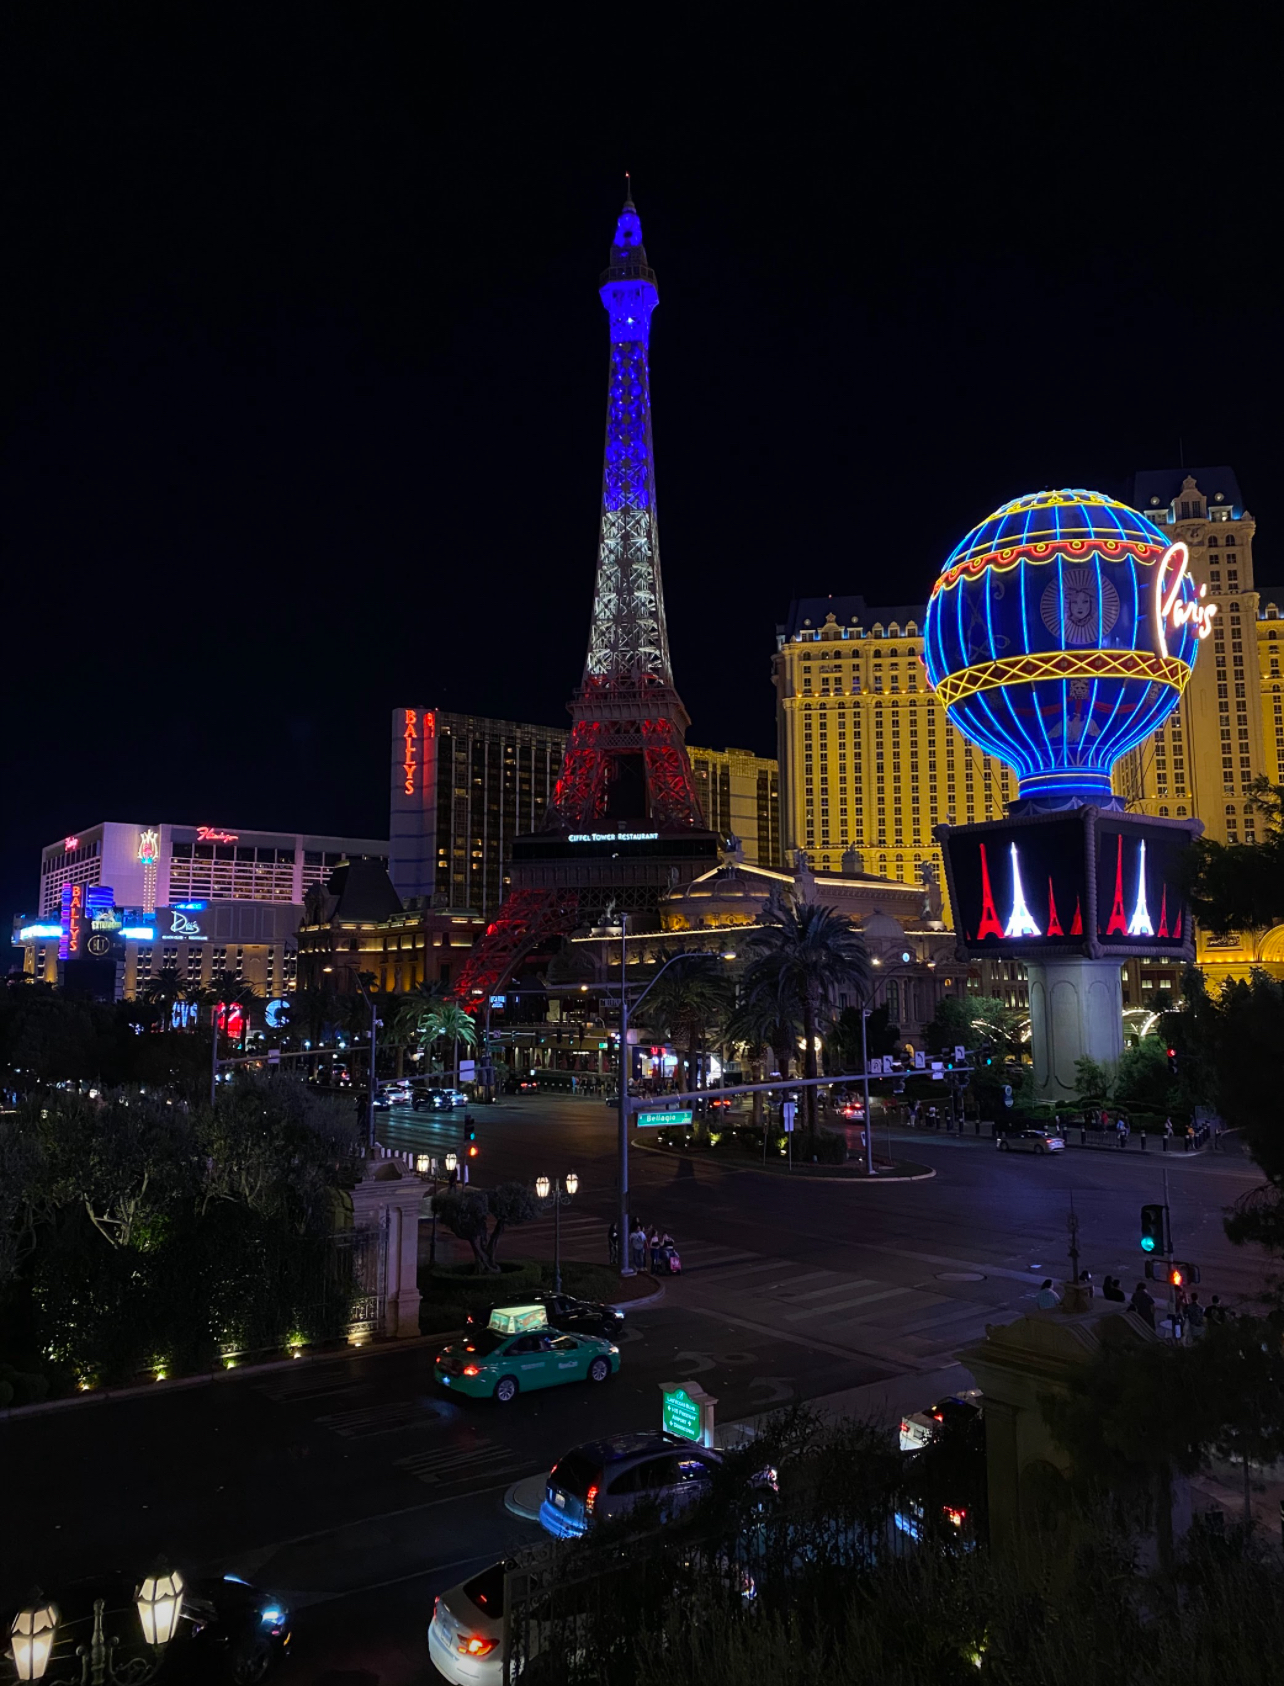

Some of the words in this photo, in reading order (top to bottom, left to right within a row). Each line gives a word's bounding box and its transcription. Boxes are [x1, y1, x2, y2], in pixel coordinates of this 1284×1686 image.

[1156, 541, 1217, 659] Paris
[403, 709, 417, 795] BALLYS
[568, 834, 590, 842] EIFFEL
[591, 833, 616, 841] TOWER
[618, 833, 658, 841] RESTAURANT
[69, 886, 81, 951] BALLYS
[646, 1114, 676, 1124] Bellagio
